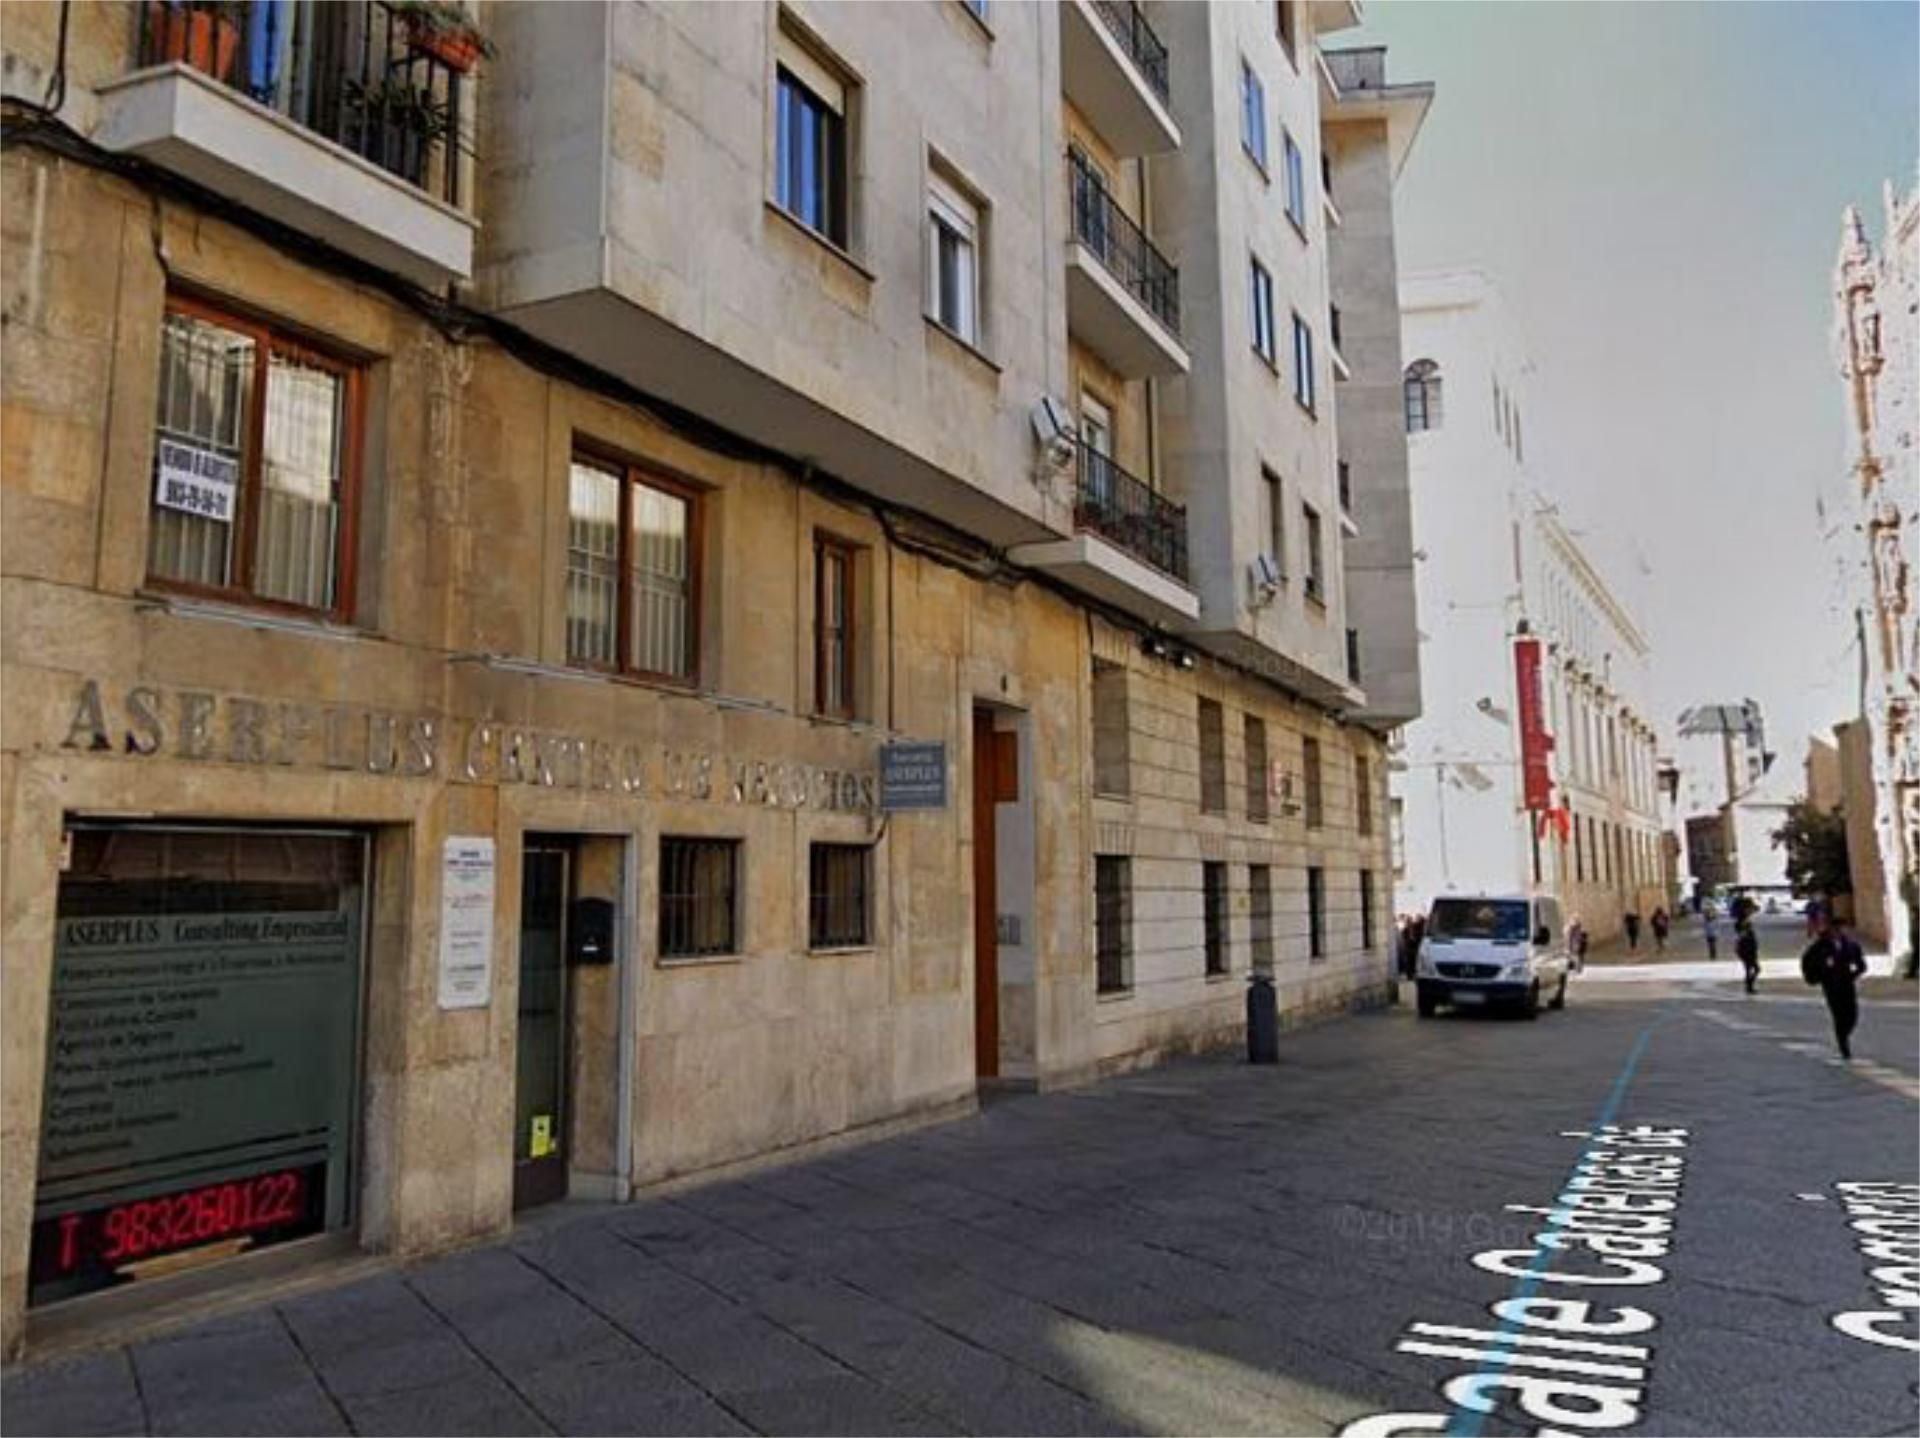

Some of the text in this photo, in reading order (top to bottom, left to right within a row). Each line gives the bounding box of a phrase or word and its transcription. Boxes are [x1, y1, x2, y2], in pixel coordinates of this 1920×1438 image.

[60, 678, 435, 777] ASERPLUS
[464, 721, 641, 791] CENTRO
[726, 756, 875, 810] NEGOCIOS
[65, 918, 160, 946] ASERPLUS
[173, 916, 258, 942] Consulting
[59, 1172, 297, 1270] T 983260122
